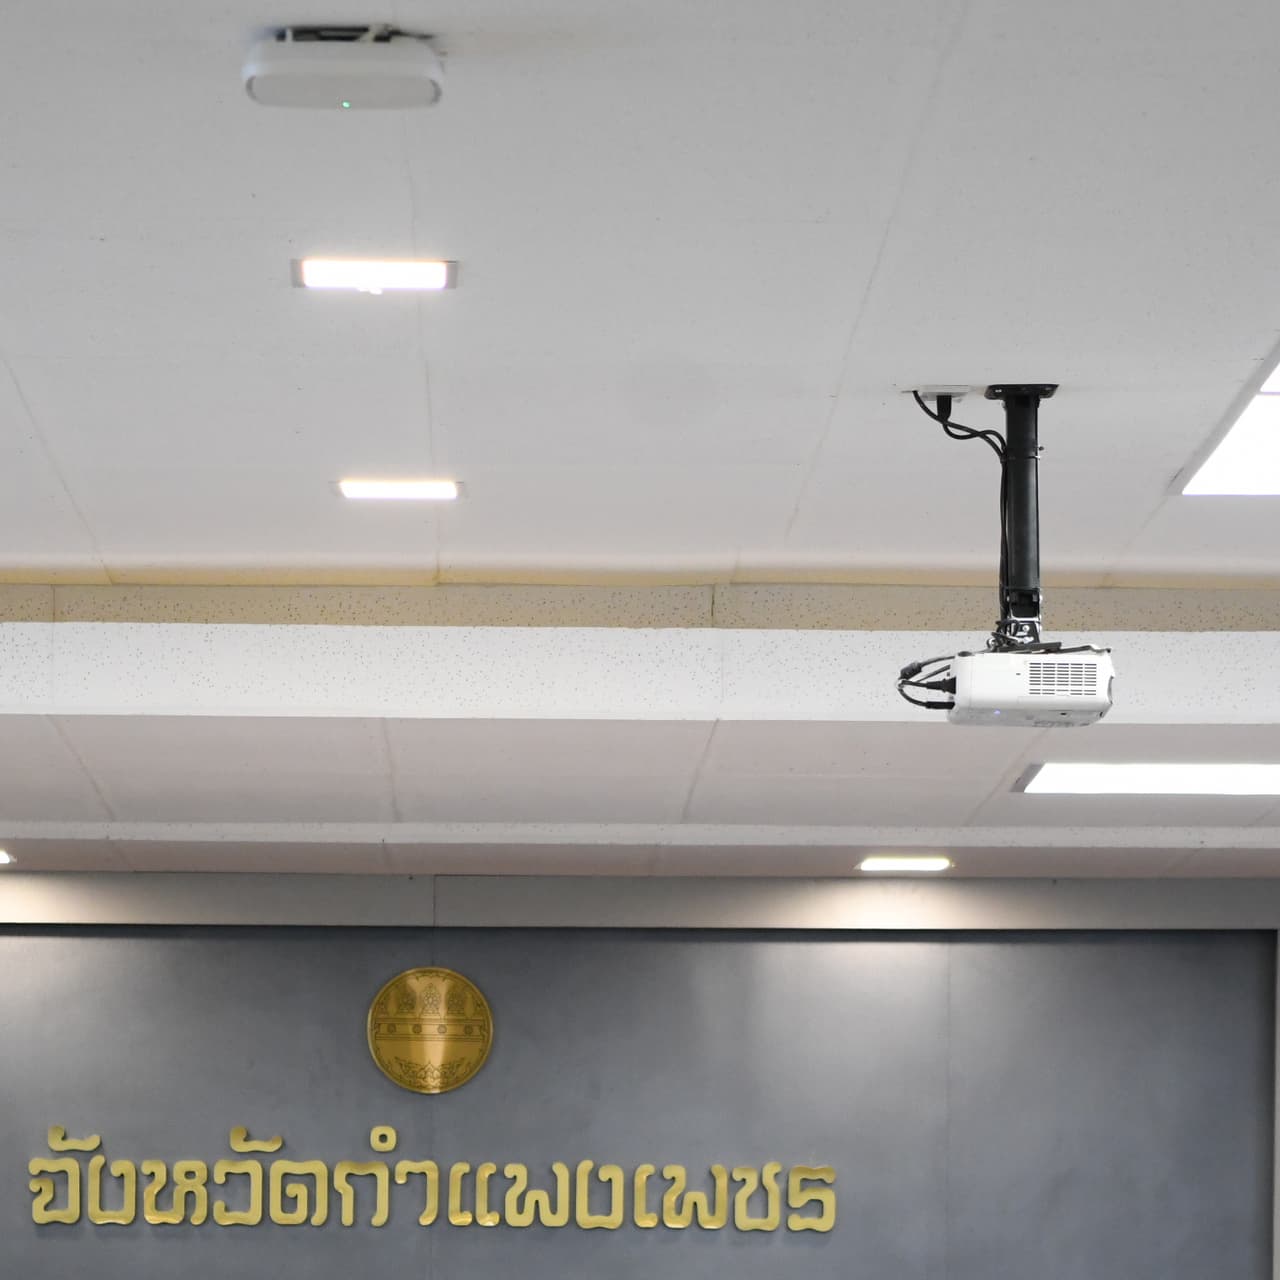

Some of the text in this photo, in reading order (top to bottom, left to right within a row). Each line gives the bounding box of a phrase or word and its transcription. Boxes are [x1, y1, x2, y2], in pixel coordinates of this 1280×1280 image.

[28, 1125, 837, 1232] จังหวัดกำแพงเพชร
